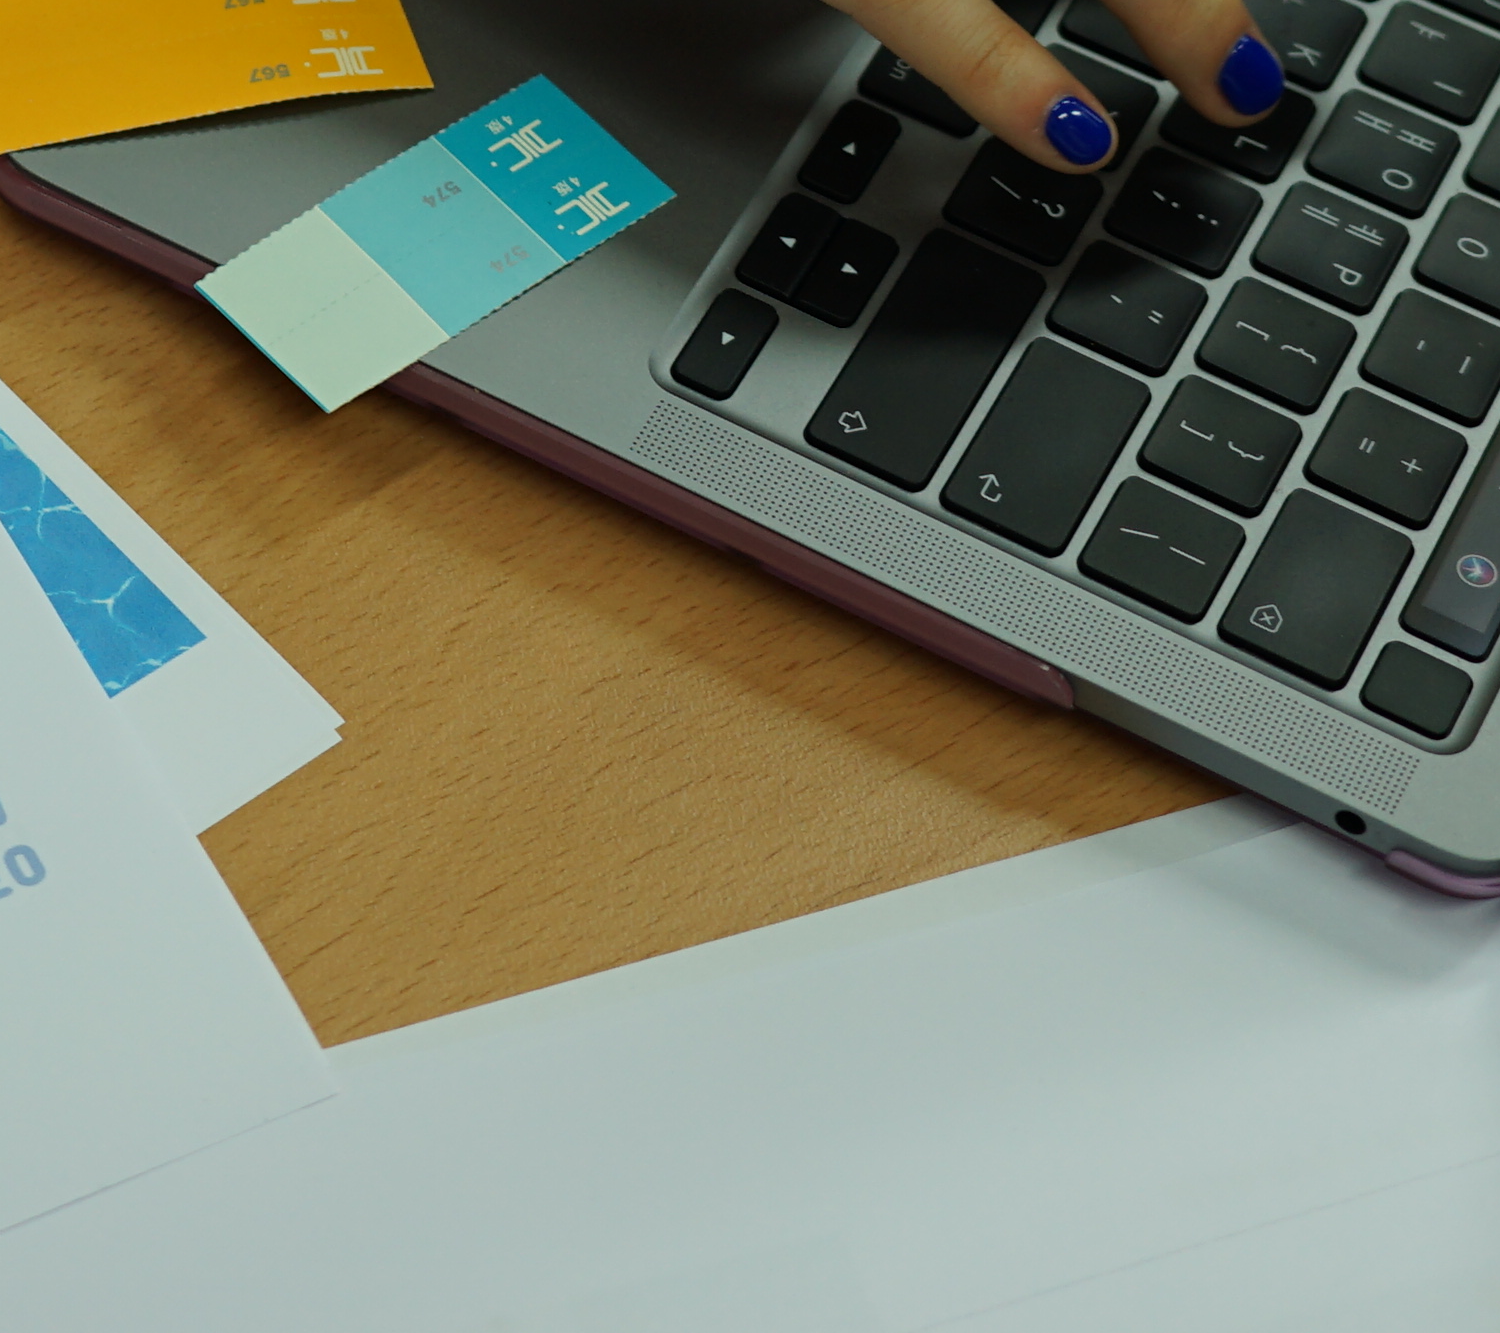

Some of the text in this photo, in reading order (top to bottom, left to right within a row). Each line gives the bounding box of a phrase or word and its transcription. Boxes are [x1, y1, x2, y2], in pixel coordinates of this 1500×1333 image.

[1288, 43, 1321, 66] K
[250, 63, 291, 83] 567
[422, 180, 463, 208] 574
[1333, 263, 1363, 286] P
